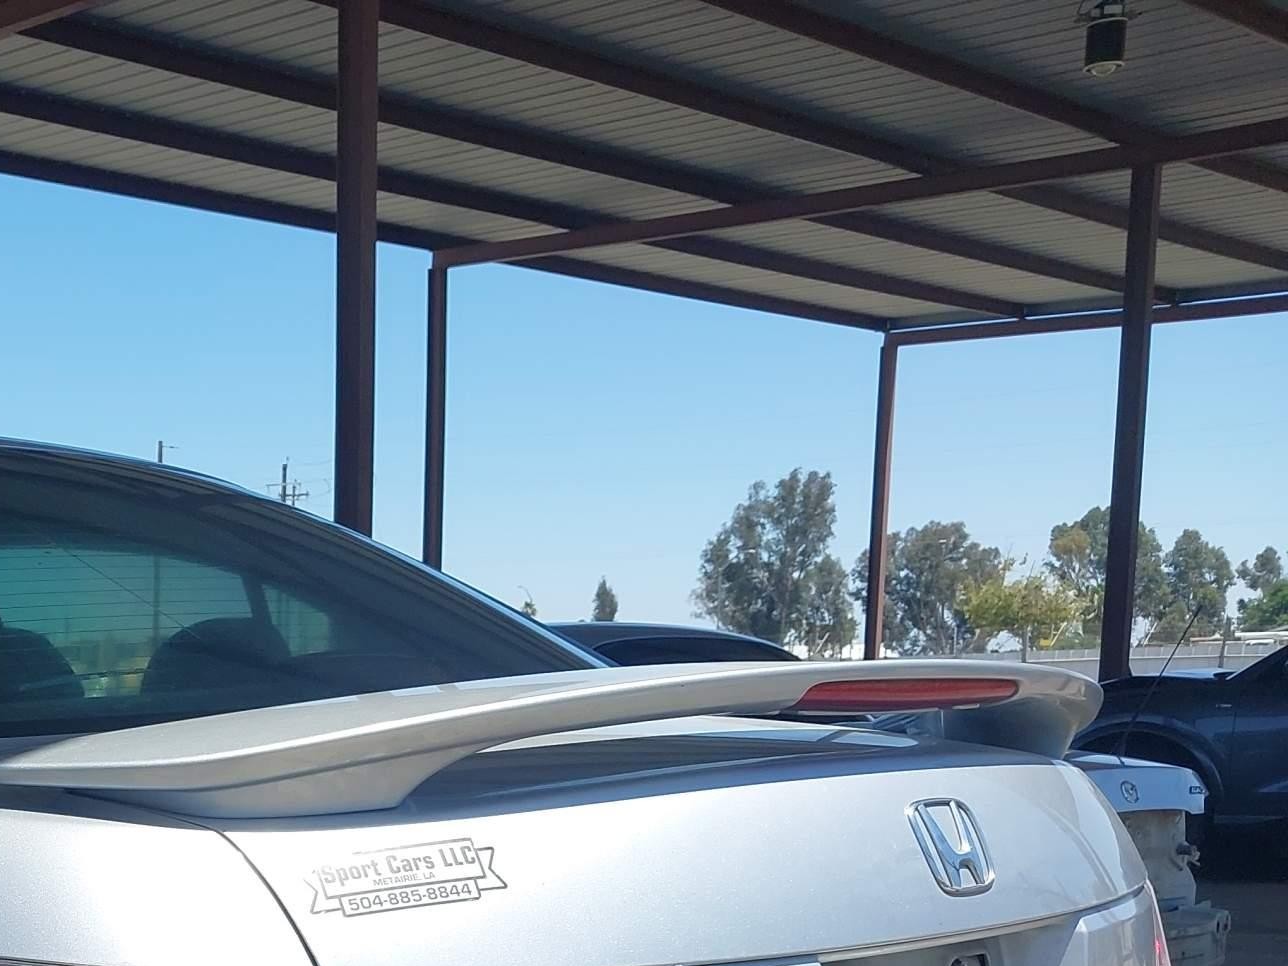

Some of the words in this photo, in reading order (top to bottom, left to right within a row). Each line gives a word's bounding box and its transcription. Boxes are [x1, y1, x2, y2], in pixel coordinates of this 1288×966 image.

[322, 860, 381, 886] Sport
[386, 855, 435, 874] Cars
[438, 845, 476, 867] LLC
[423, 871, 436, 880] LA
[349, 883, 472, 912] 504-885-8844
